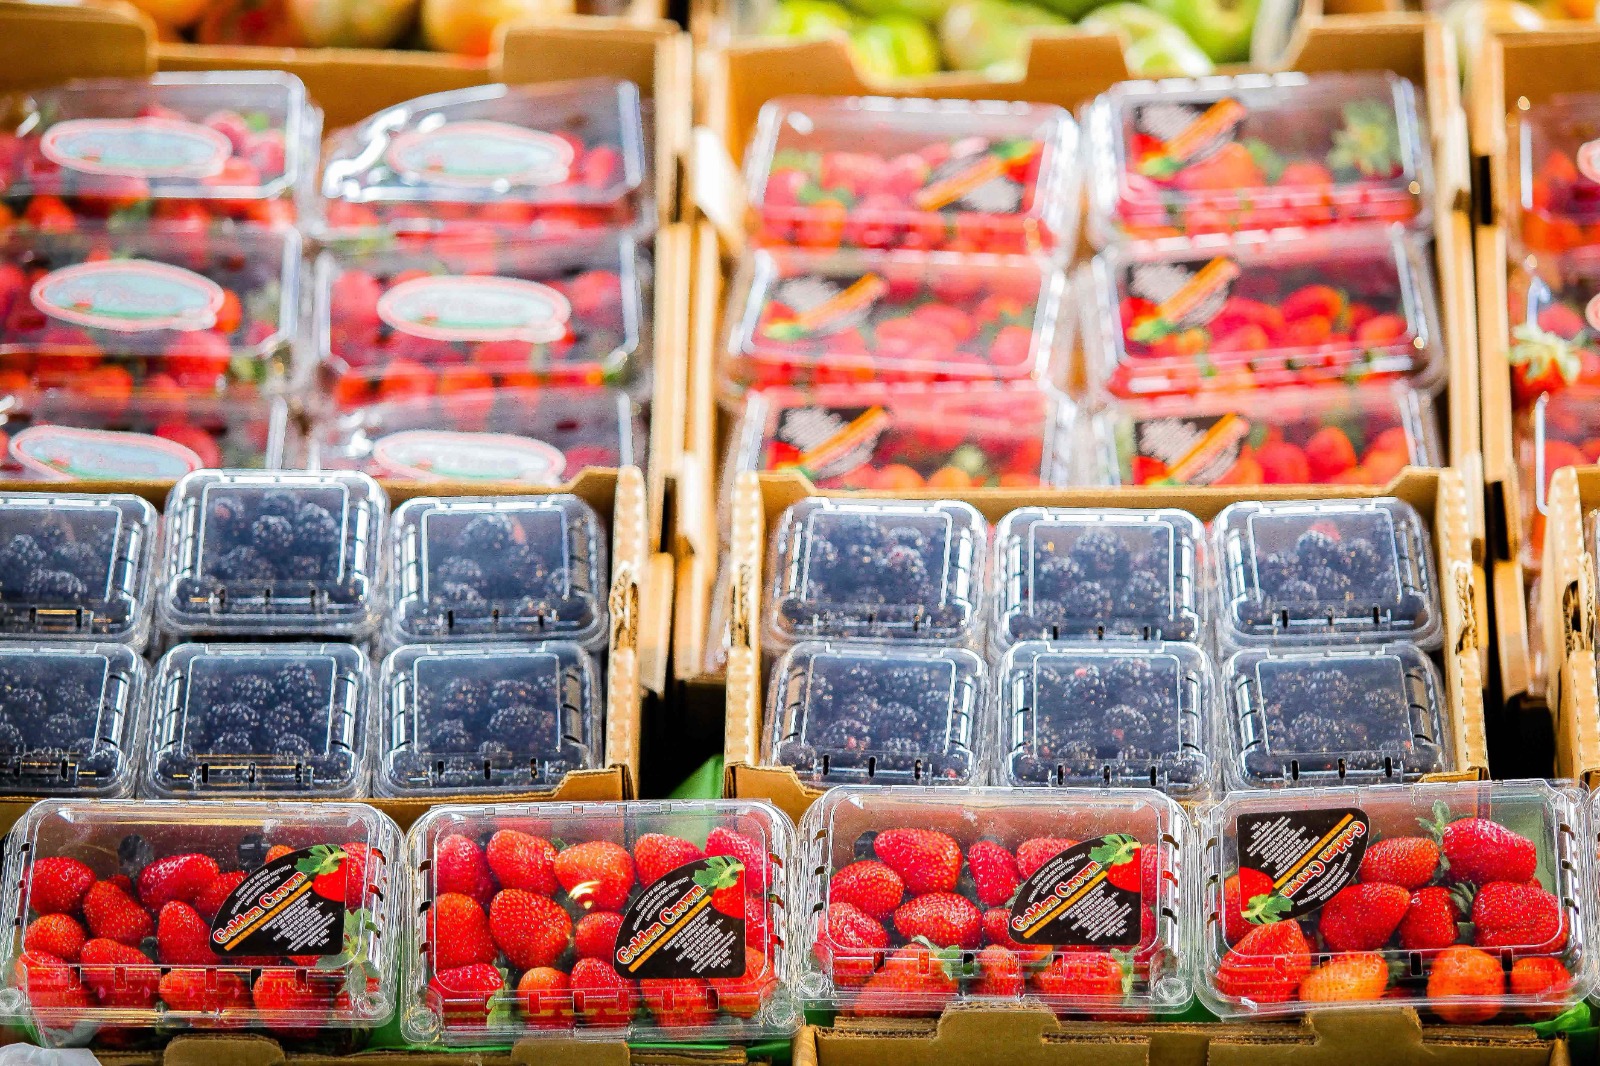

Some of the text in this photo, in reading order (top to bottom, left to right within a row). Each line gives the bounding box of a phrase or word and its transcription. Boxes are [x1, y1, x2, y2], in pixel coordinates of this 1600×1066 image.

[1318, 821, 1366, 862] Golden
[213, 906, 265, 944] Golden
[259, 872, 307, 908] Crown
[1012, 895, 1061, 931] Golden
[1055, 860, 1102, 897] Crown
[1279, 860, 1326, 898] Crown
[617, 922, 666, 964] Golden
[660, 885, 706, 925] Crown
